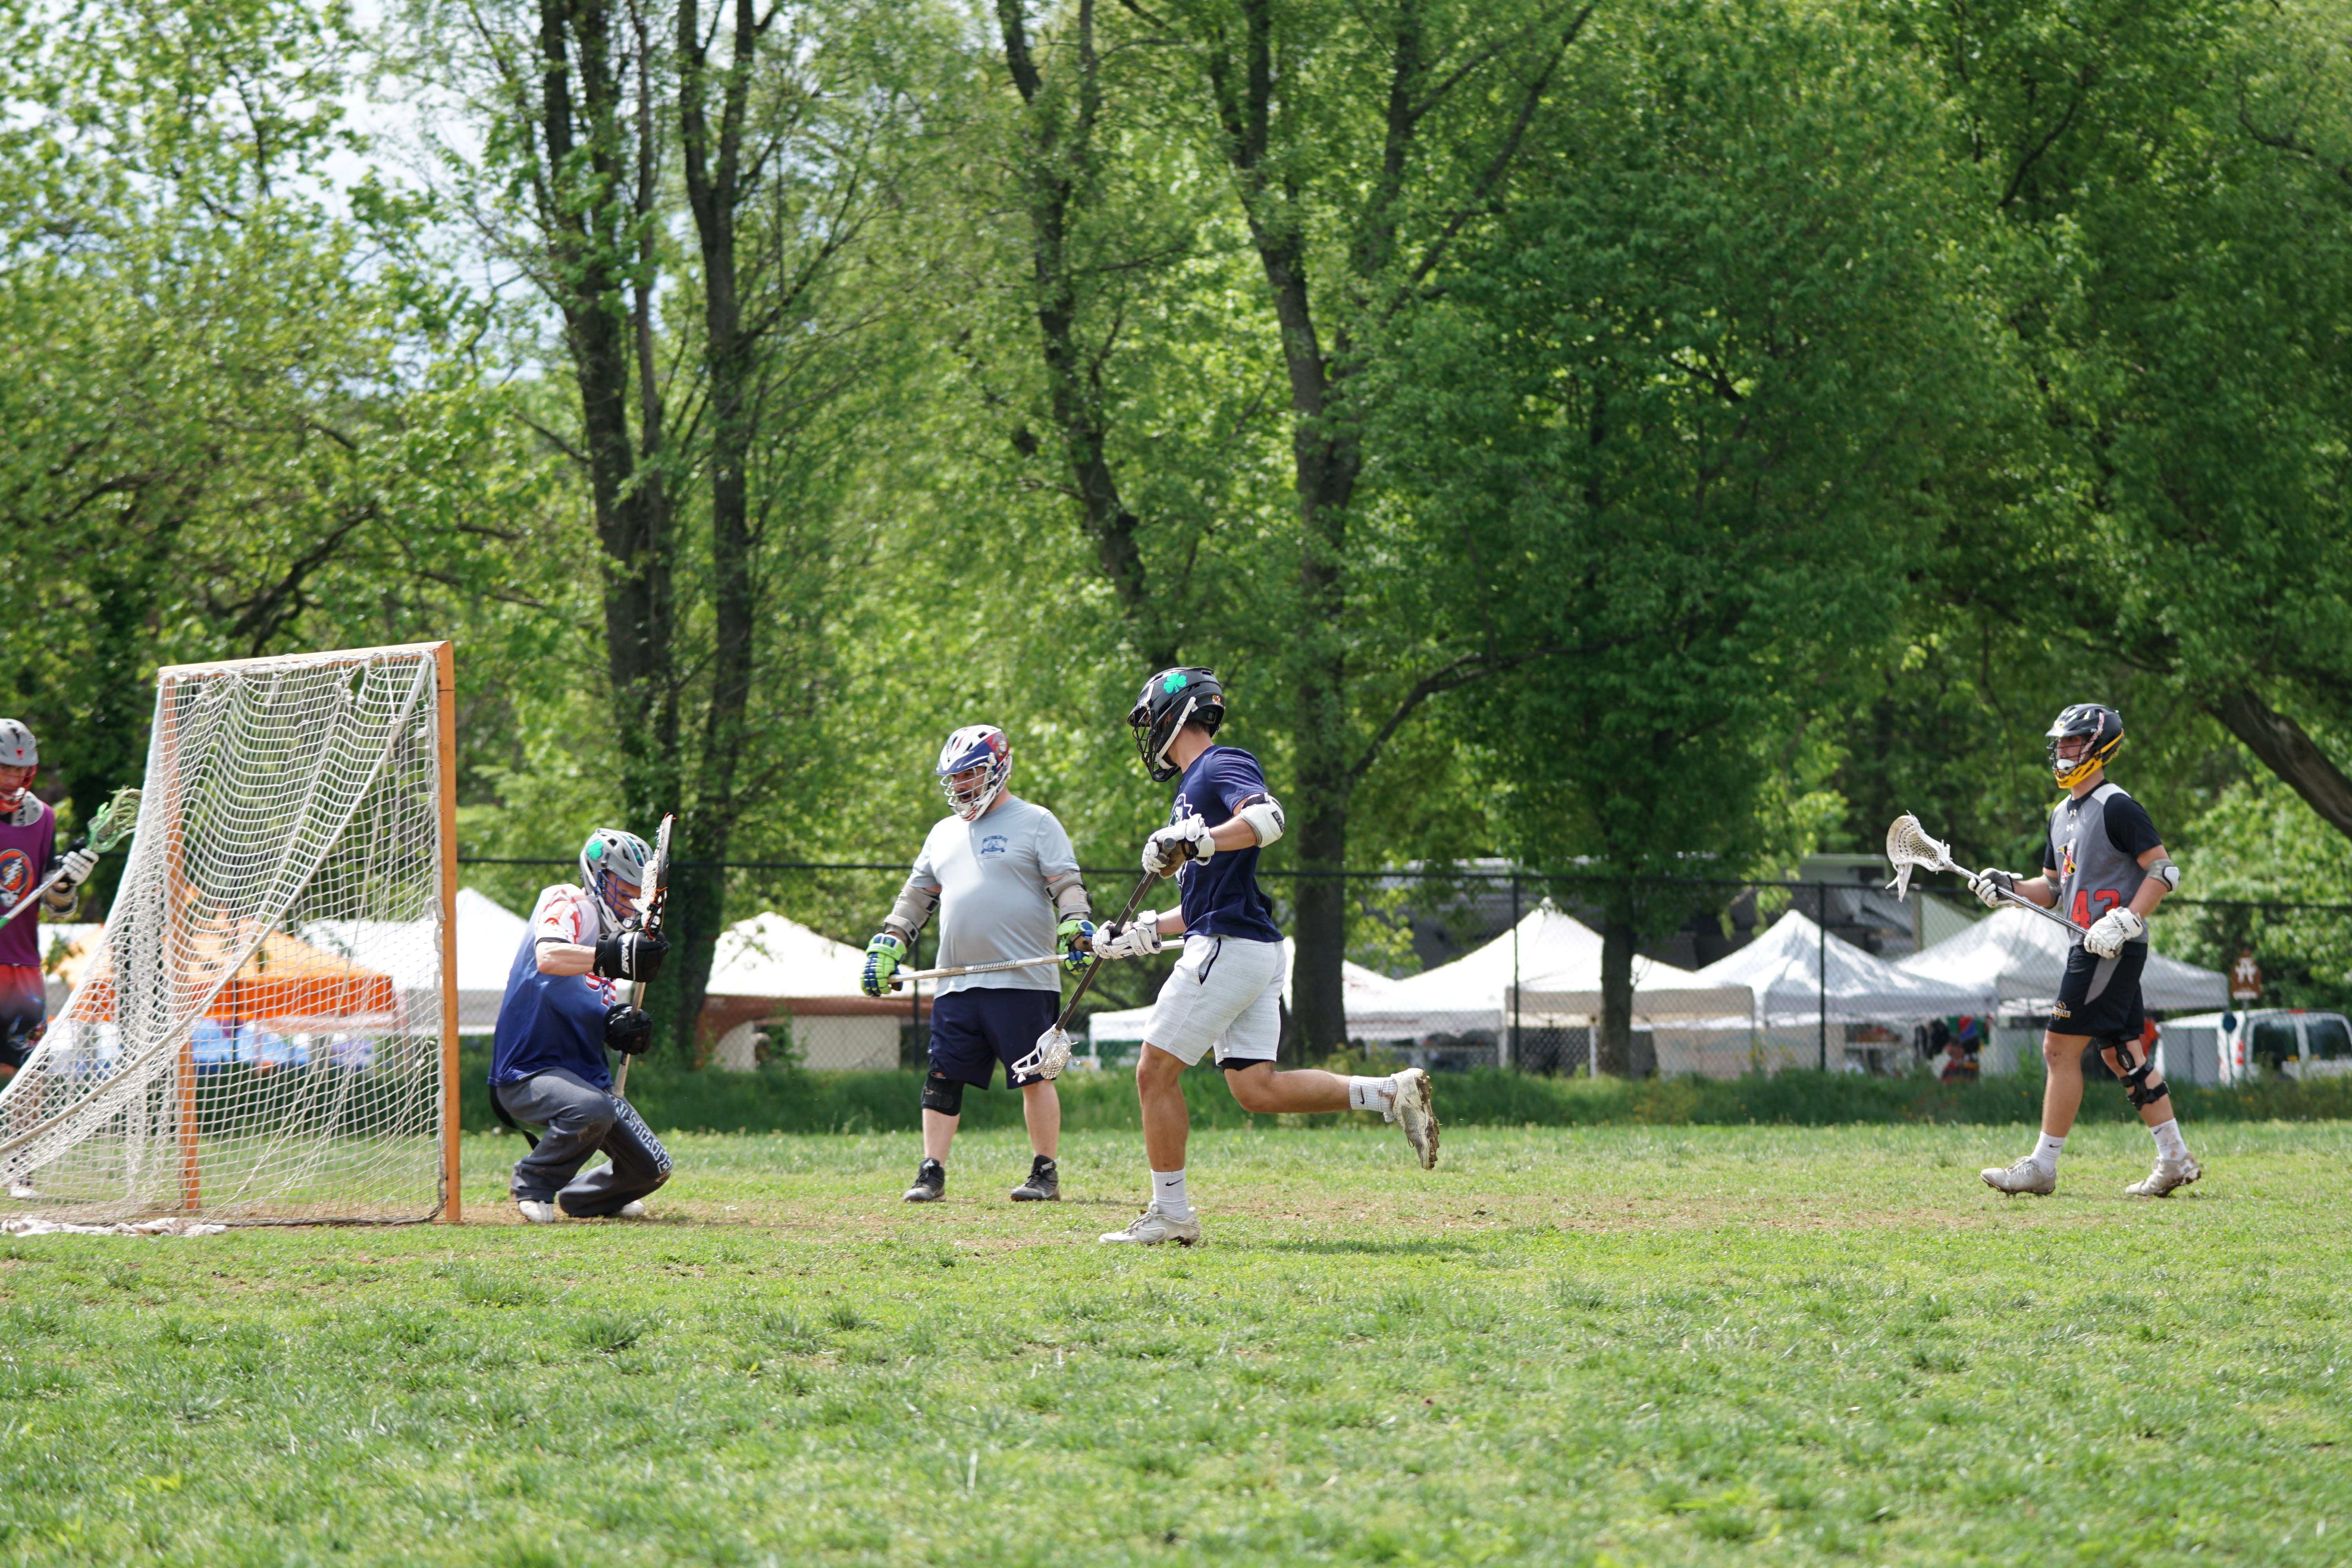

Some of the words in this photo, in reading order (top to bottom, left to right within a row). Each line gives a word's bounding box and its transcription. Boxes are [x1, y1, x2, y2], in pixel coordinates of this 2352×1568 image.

[2111, 912, 2129, 935] BRINE
[621, 936, 631, 974] BRIN
[626, 1112, 673, 1174] STATE
